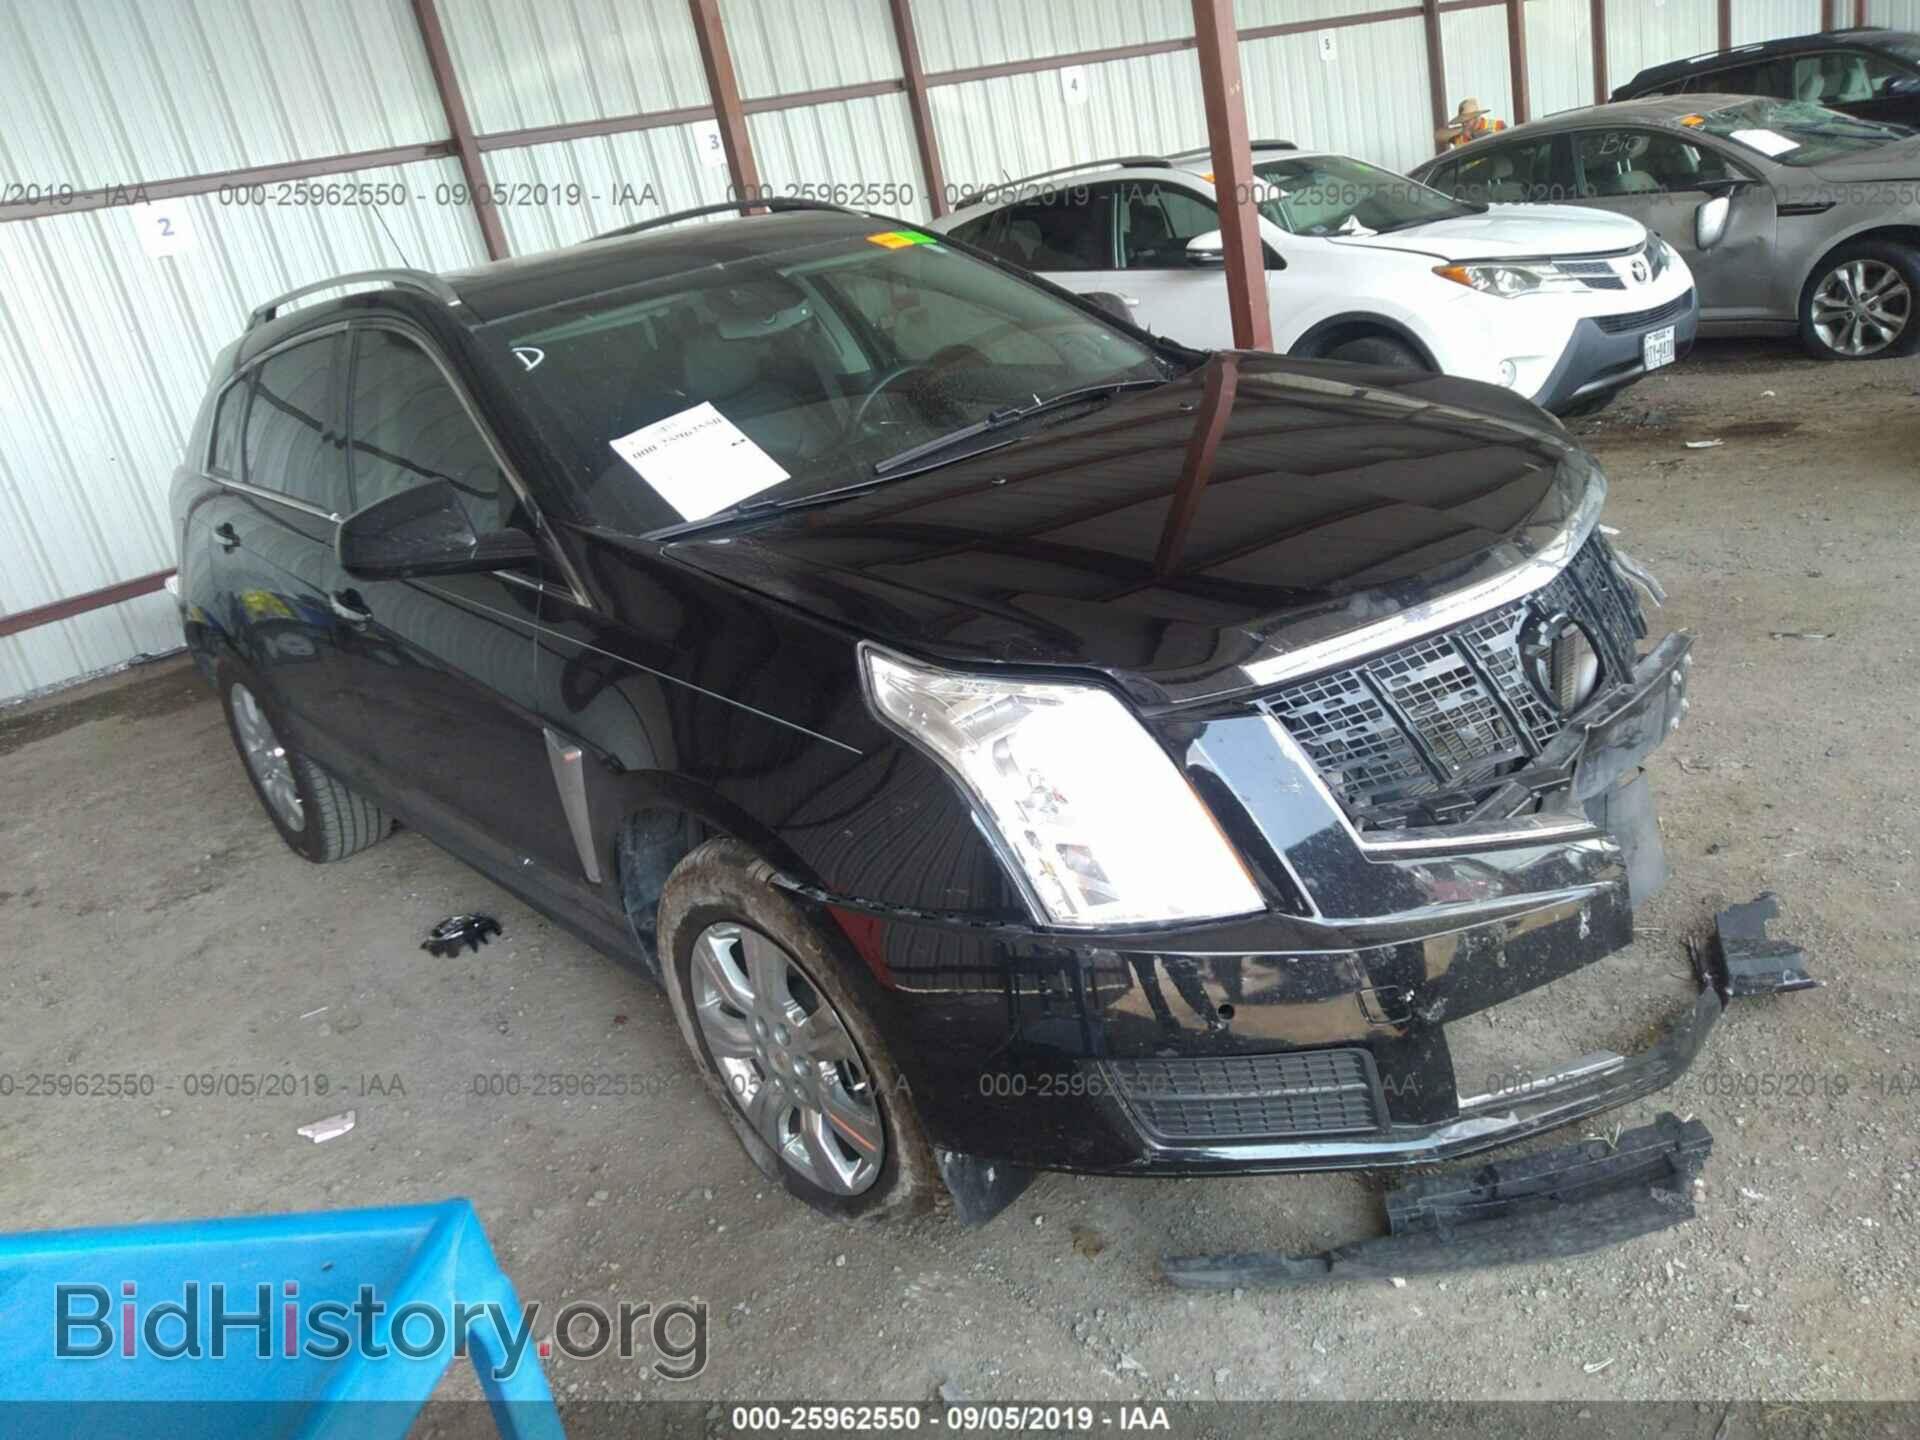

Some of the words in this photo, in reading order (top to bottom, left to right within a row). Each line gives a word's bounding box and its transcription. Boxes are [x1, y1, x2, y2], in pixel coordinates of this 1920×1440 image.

[1070, 77, 1079, 92] 4
[708, 133, 720, 150] 3
[157, 217, 175, 237] 2
[511, 347, 545, 372] D
